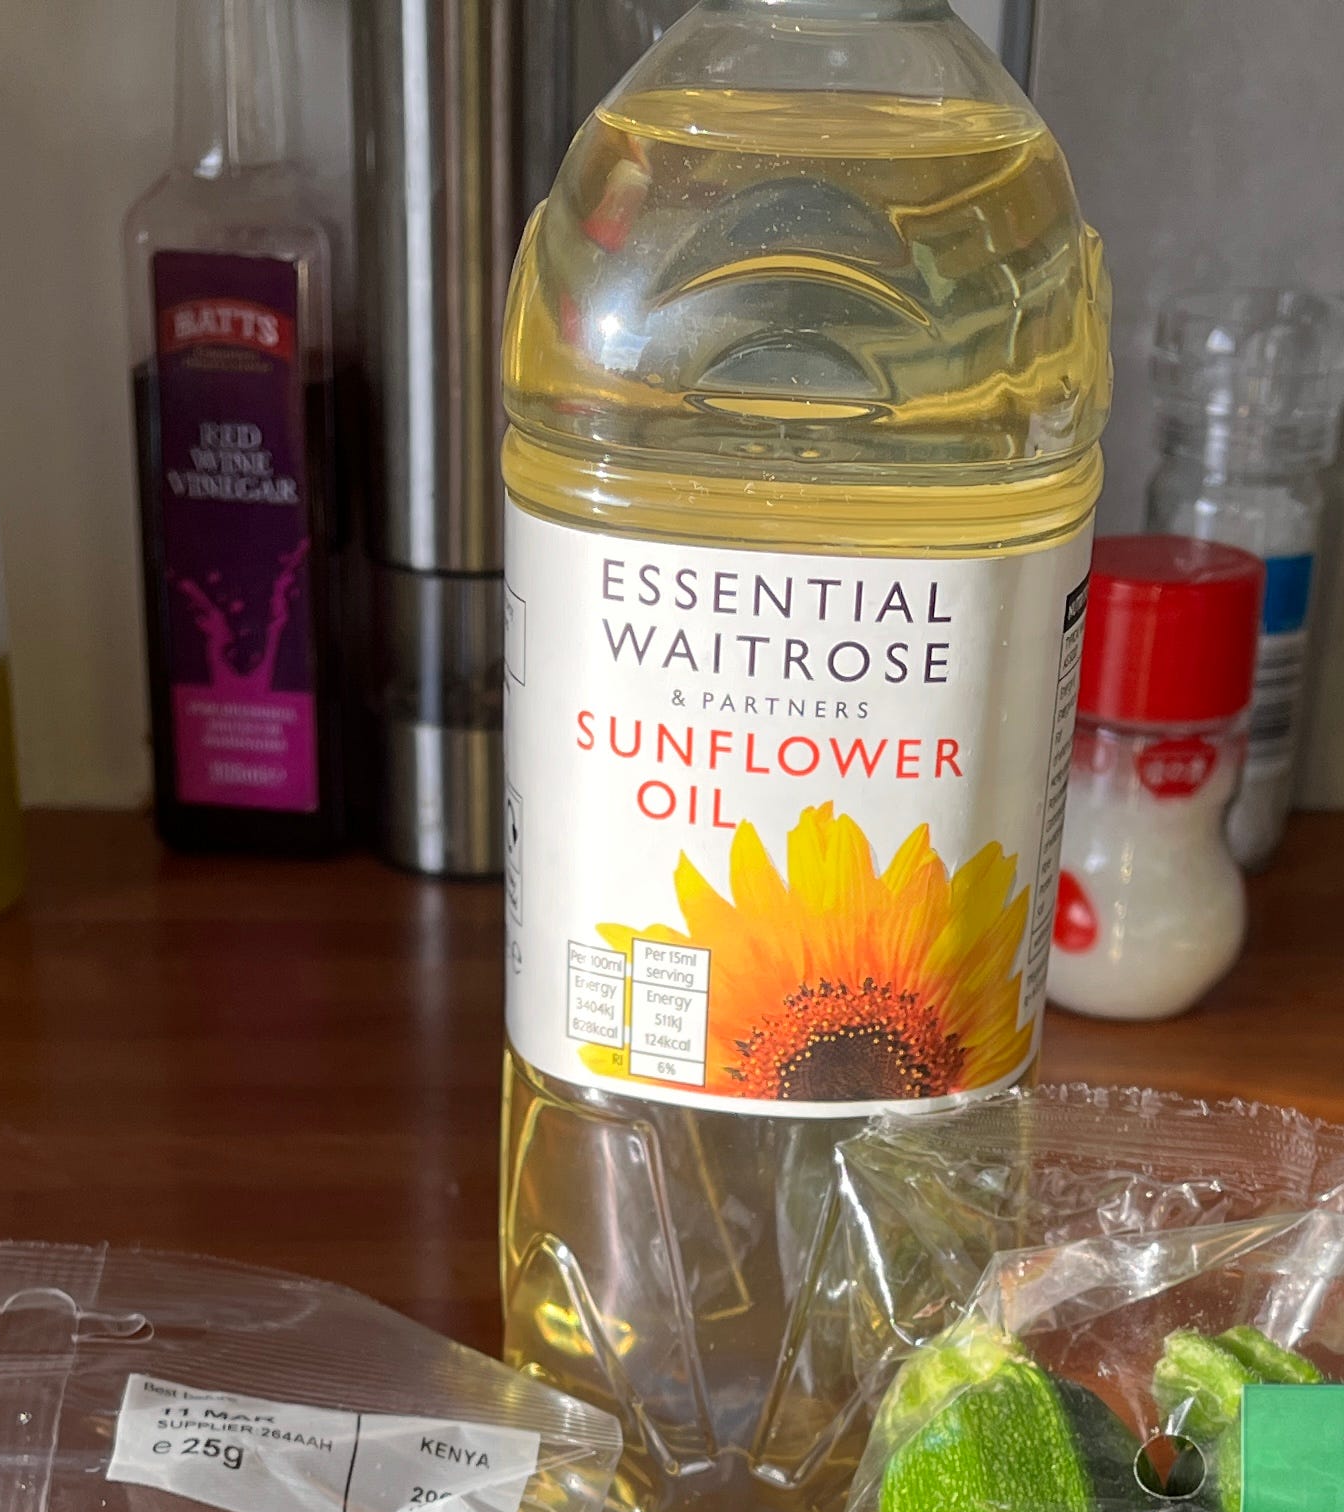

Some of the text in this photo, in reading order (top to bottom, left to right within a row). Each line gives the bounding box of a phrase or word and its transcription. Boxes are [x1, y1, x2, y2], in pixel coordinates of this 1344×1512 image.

[601, 558, 953, 624] ESSENTIAL
[601, 618, 951, 685] WAITROSE
[671, 688, 870, 721] & PARTNERS
[576, 710, 965, 780] SUNFLOWER
[636, 780, 739, 830] OIL
[591, 955, 623, 973] 100ml
[645, 947, 698, 967] Per 15ml
[575, 974, 617, 999] Energy
[646, 967, 695, 988] serving
[646, 989, 693, 1013] Energy
[572, 1017, 618, 1040] 828kcal
[645, 1032, 692, 1053] 124kcal
[657, 1061, 677, 1076] 6%
[144, 1381, 177, 1398] Best
[157, 1419, 334, 1453] SUPPLIER 264AAH
[180, 1437, 246, 1471] 25g
[419, 1436, 491, 1470] KENYA
